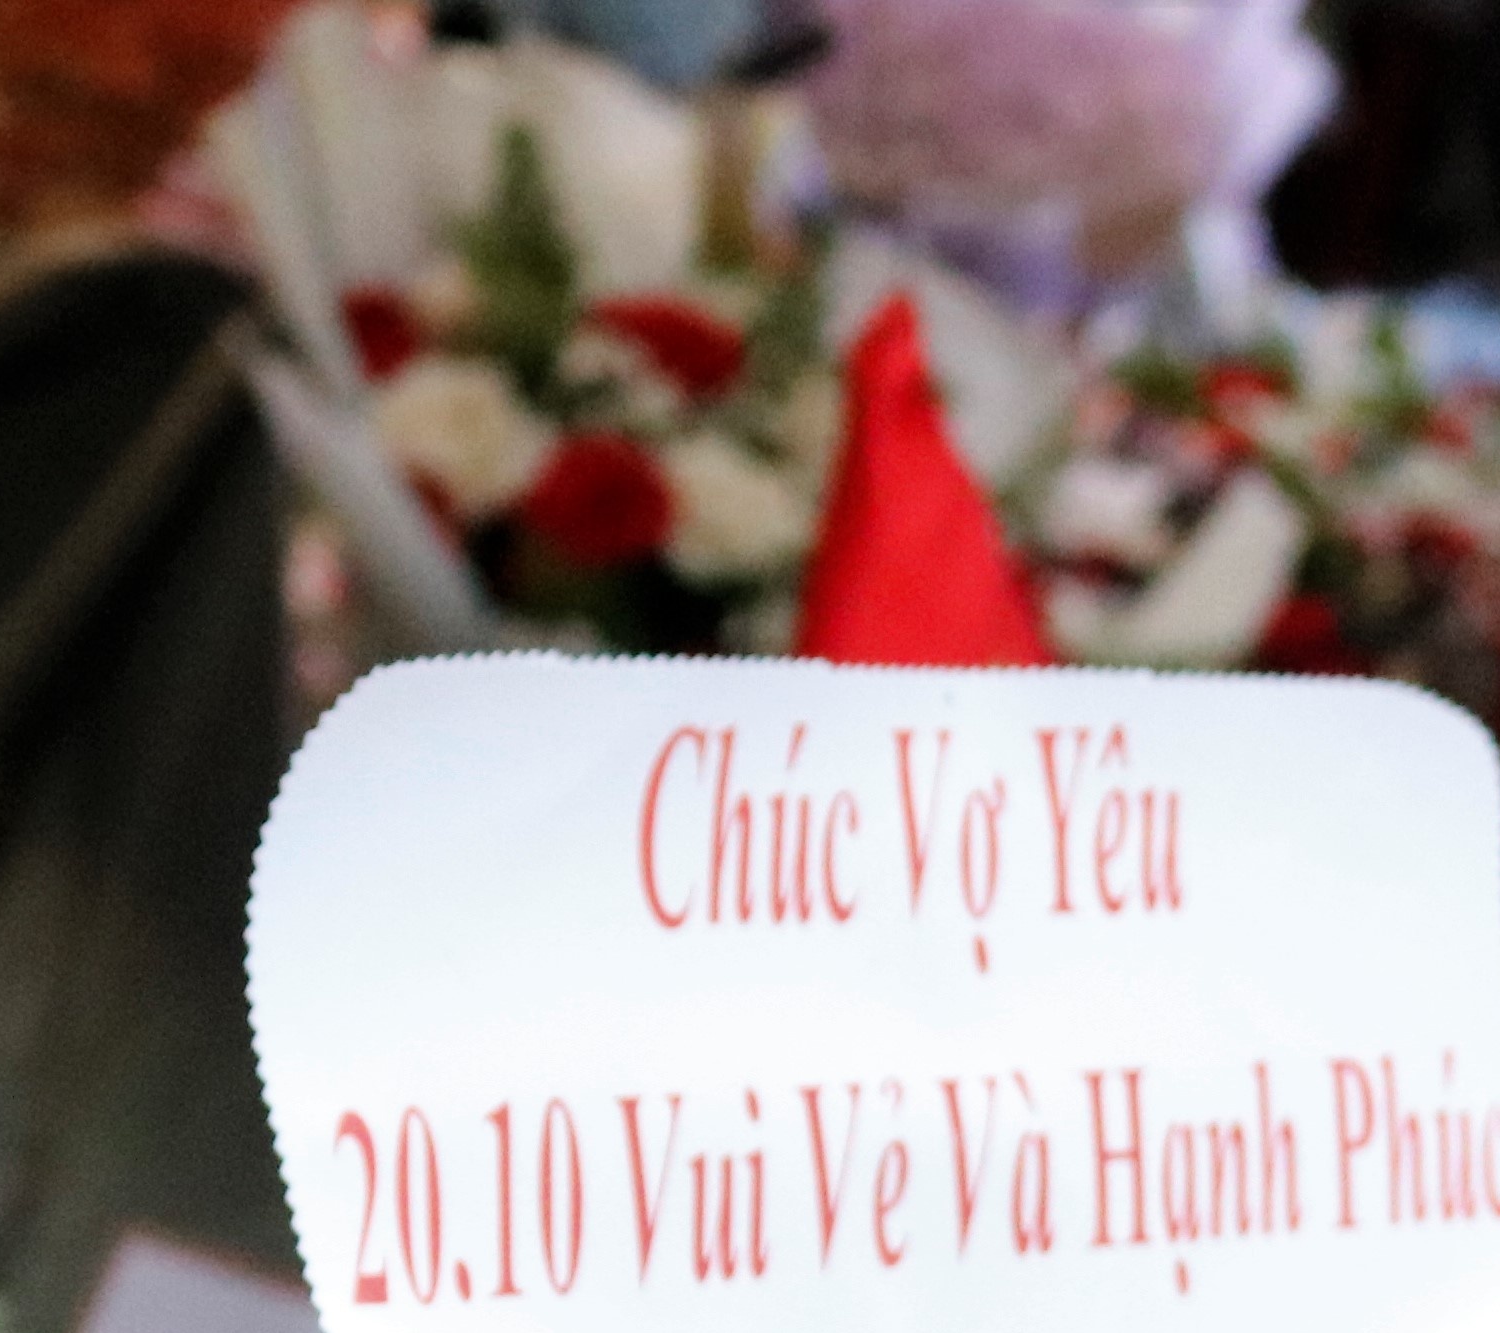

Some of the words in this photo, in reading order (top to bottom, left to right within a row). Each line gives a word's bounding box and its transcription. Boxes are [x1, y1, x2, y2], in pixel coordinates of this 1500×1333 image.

[636, 722, 860, 931] Chúc
[892, 728, 1008, 974] Vợ
[1033, 722, 1184, 915] Yêu
[334, 1098, 587, 1306] 20.10
[617, 1087, 770, 1284] Vui
[938, 1069, 1056, 1257] Và
[1082, 1060, 1303, 1294] Hạnh
